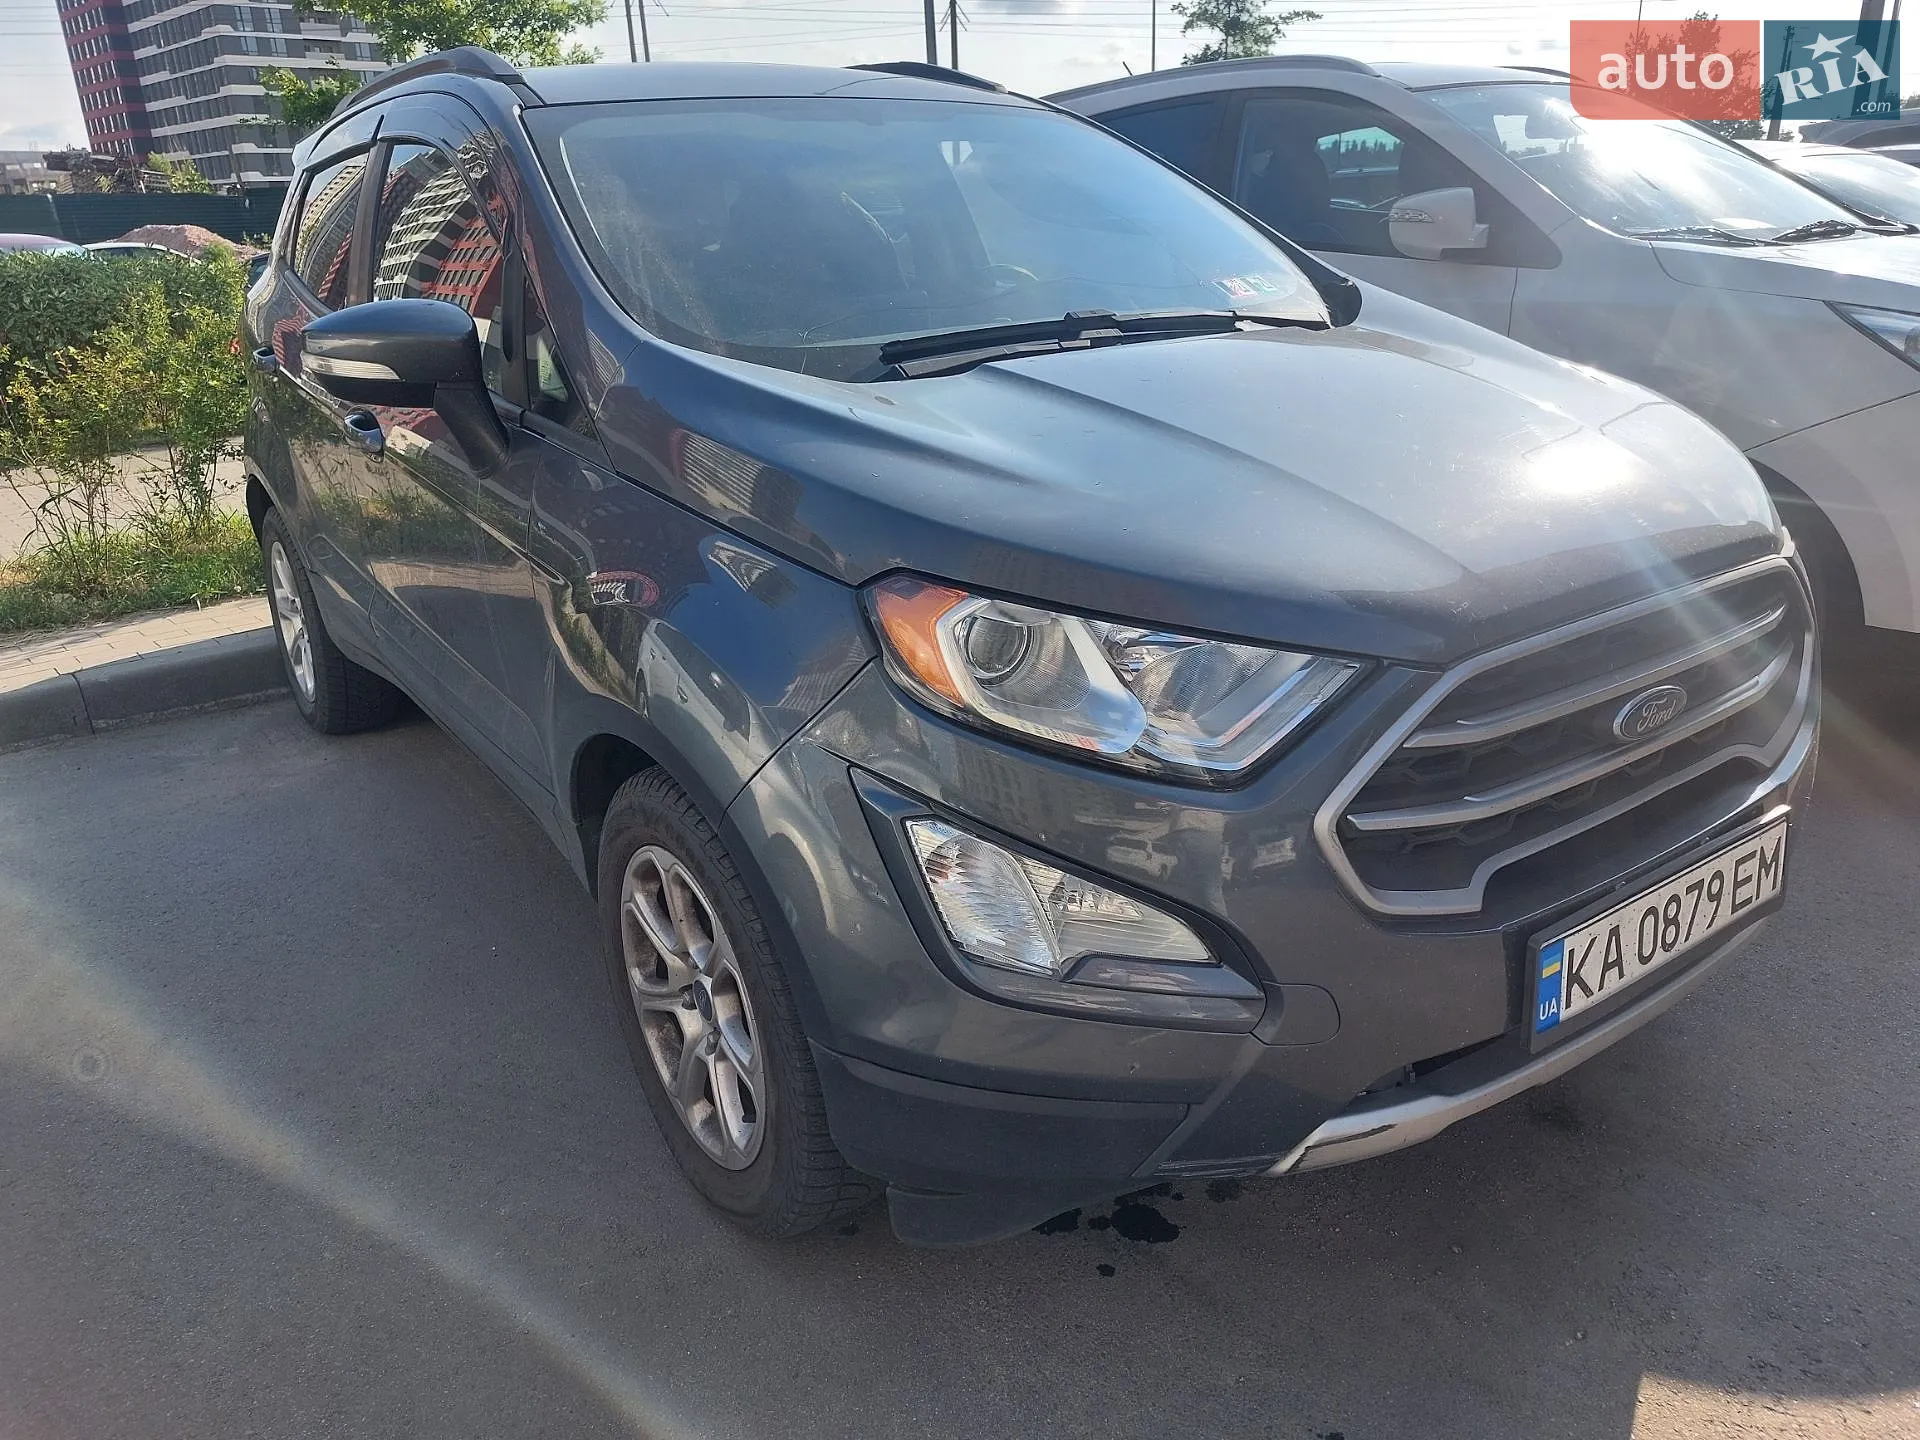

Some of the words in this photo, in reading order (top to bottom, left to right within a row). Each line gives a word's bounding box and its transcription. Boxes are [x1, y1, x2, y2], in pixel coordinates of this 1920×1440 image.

[1637, 697, 1677, 732] Ford
[1564, 924, 1625, 1010] KA
[1637, 870, 1725, 966] 0879
[1731, 836, 1781, 915] EM
[1539, 997, 1558, 1021] UA
